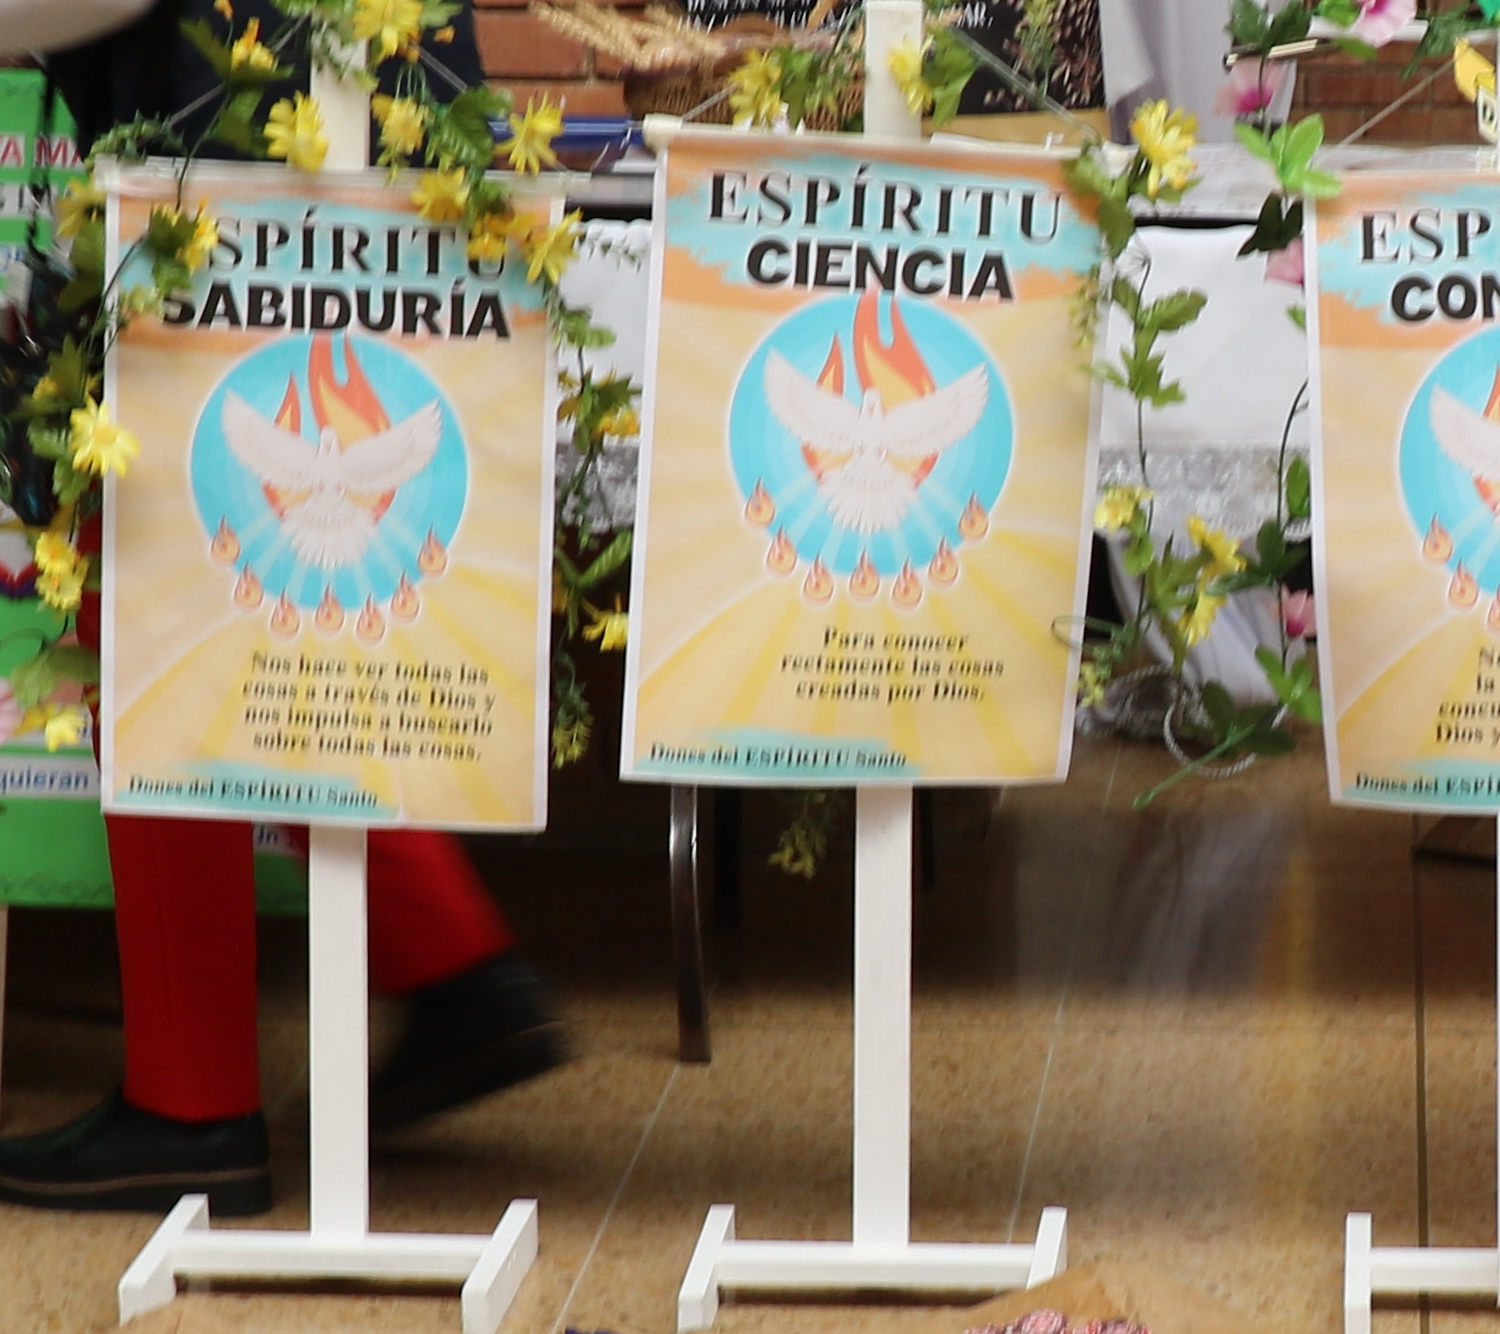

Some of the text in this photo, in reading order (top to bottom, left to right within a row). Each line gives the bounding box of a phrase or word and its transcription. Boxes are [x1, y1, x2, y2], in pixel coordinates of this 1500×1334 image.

[707, 163, 1064, 246] ESPÍRITU
[745, 234, 1015, 303] CIENCIA
[162, 276, 510, 341] SABIDURÍA
[823, 626, 969, 653] Para conocer
[780, 652, 1005, 679] rectamente las cosas
[795, 678, 880, 702] creadas
[887, 682, 926, 707] por
[1476, 672, 1495, 694] la
[1435, 720, 1485, 743] Dios
